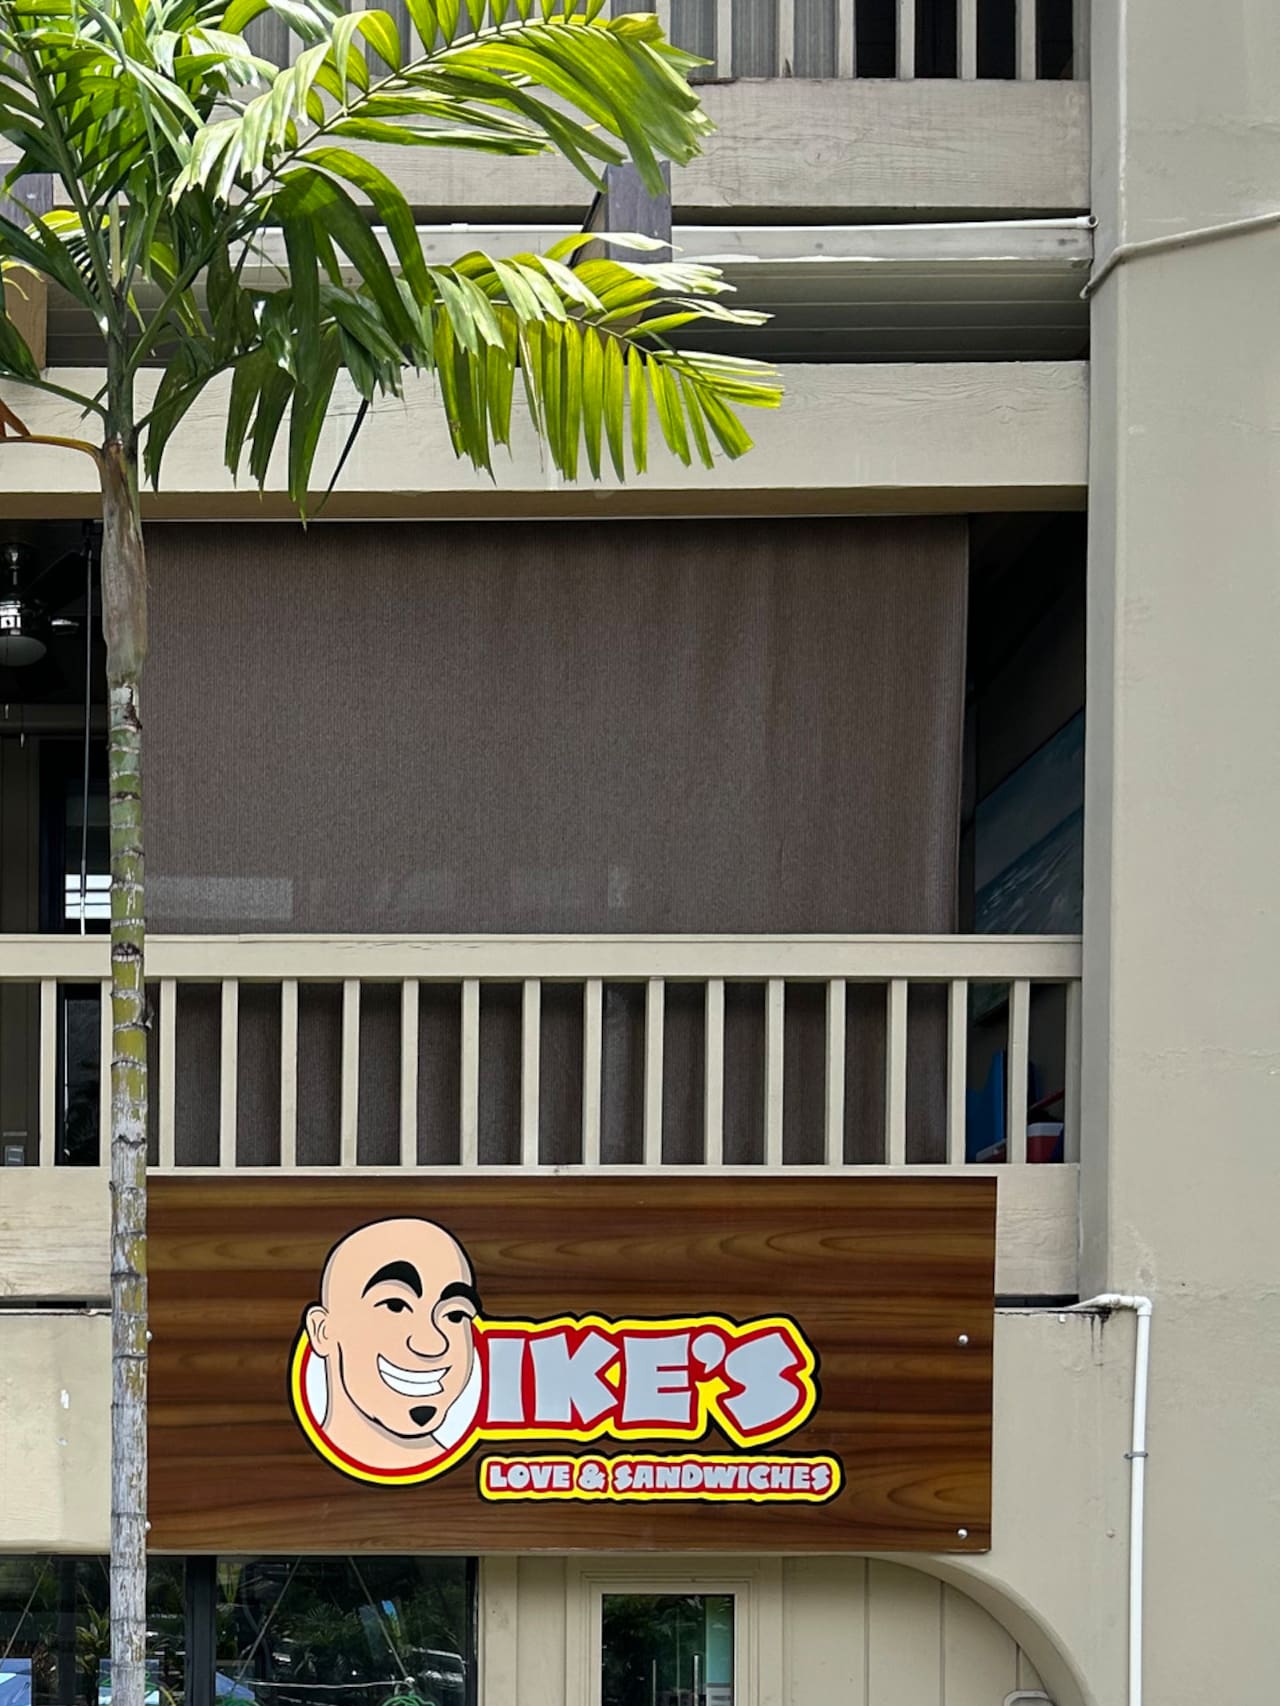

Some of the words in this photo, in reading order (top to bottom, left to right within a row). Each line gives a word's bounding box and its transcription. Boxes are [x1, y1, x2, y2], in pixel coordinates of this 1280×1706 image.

[488, 1331, 809, 1435] IKE'S
[489, 1463, 572, 1490] LOVE
[577, 1463, 607, 1491] &
[612, 1462, 833, 1493] SANDWICHES
